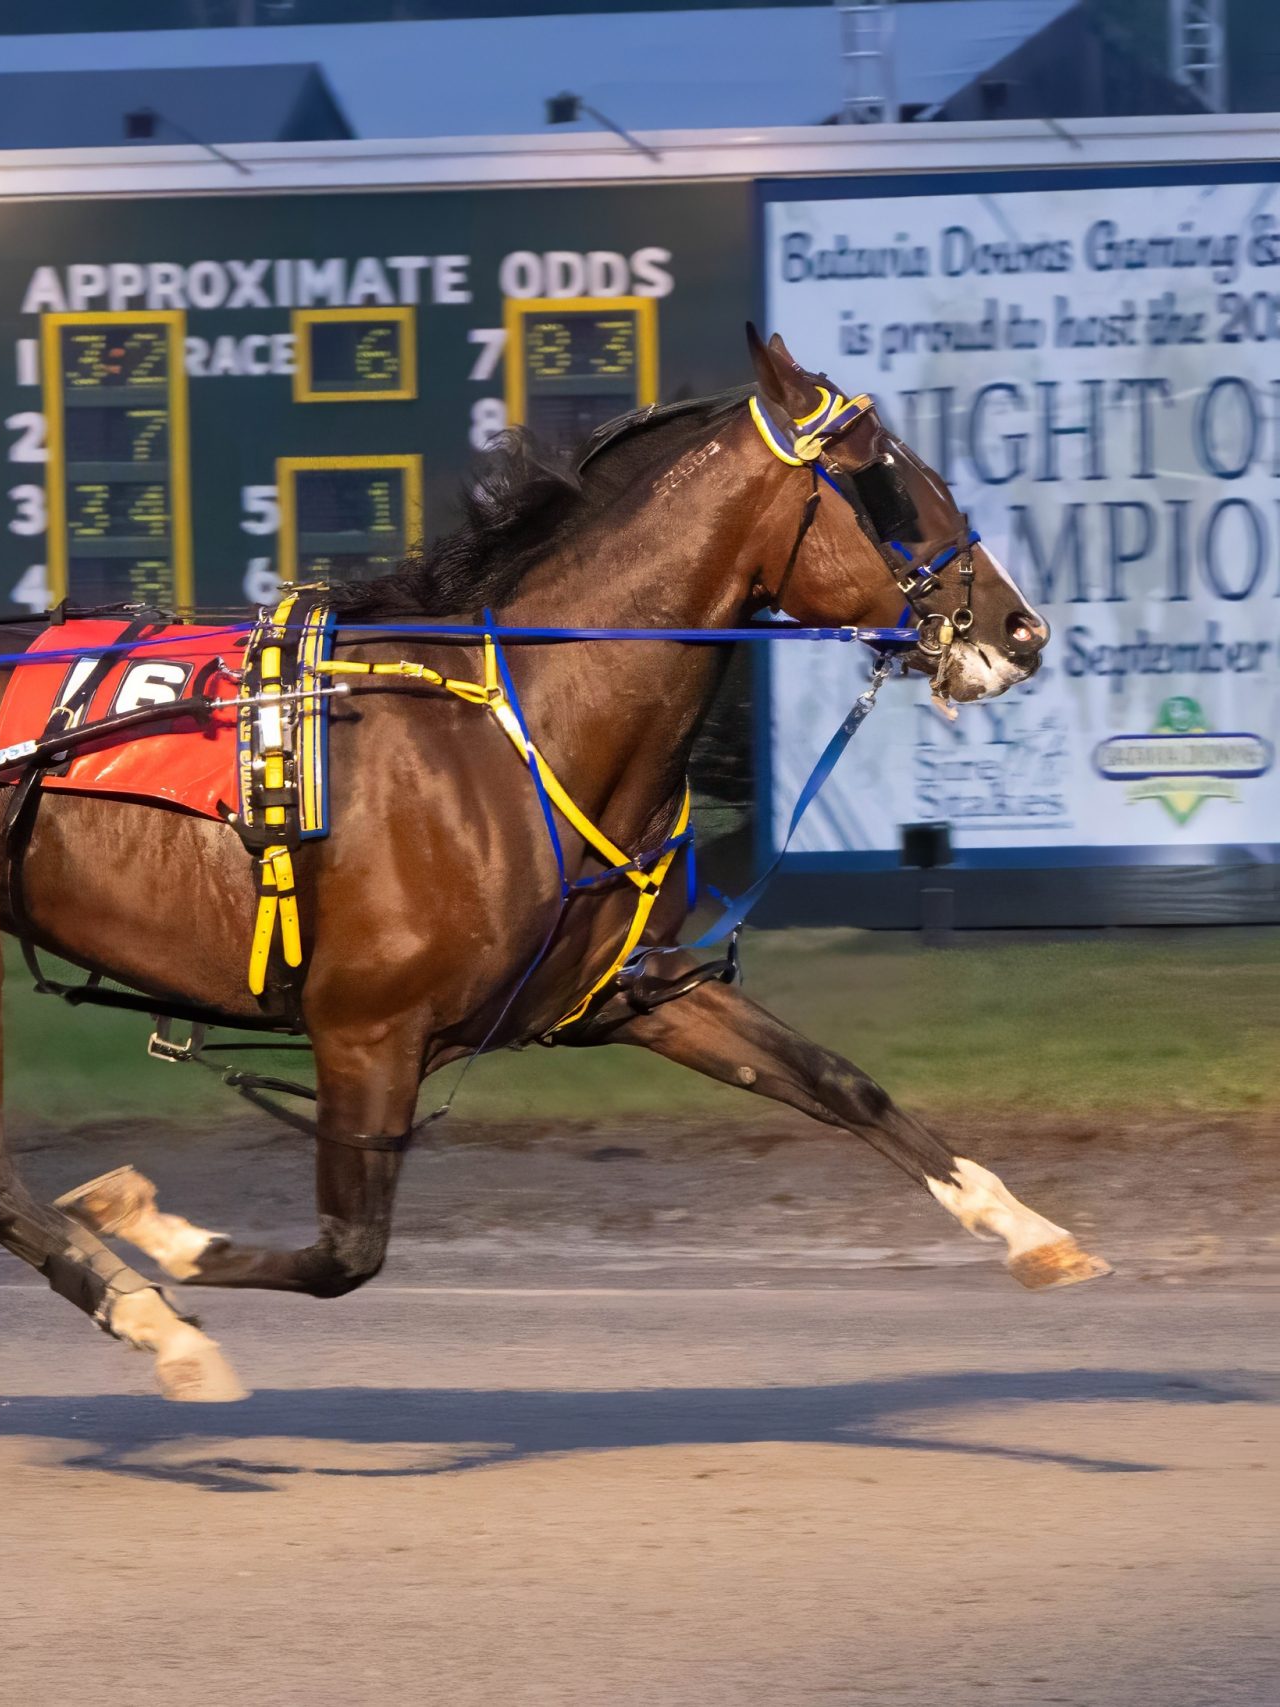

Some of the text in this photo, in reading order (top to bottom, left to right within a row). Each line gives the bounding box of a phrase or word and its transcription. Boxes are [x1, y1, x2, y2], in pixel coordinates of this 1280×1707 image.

[1085, 219, 1238, 285] Gaming
[22, 247, 674, 313] APPROXIMATE ODDS
[184, 334, 299, 377] RACE
[355, 327, 400, 380] 6
[468, 328, 508, 380] 7
[839, 310, 872, 355] is
[16, 338, 40, 385] 1
[5, 411, 51, 463] 2
[126, 410, 168, 461] 7
[470, 398, 508, 450] 8
[1194, 376, 1280, 480] O
[7, 484, 49, 535] 3
[240, 484, 281, 535] 5
[1007, 496, 1280, 604] MPIO
[10, 564, 54, 613] 4
[243, 556, 284, 607] 6
[1063, 620, 1271, 694] September
